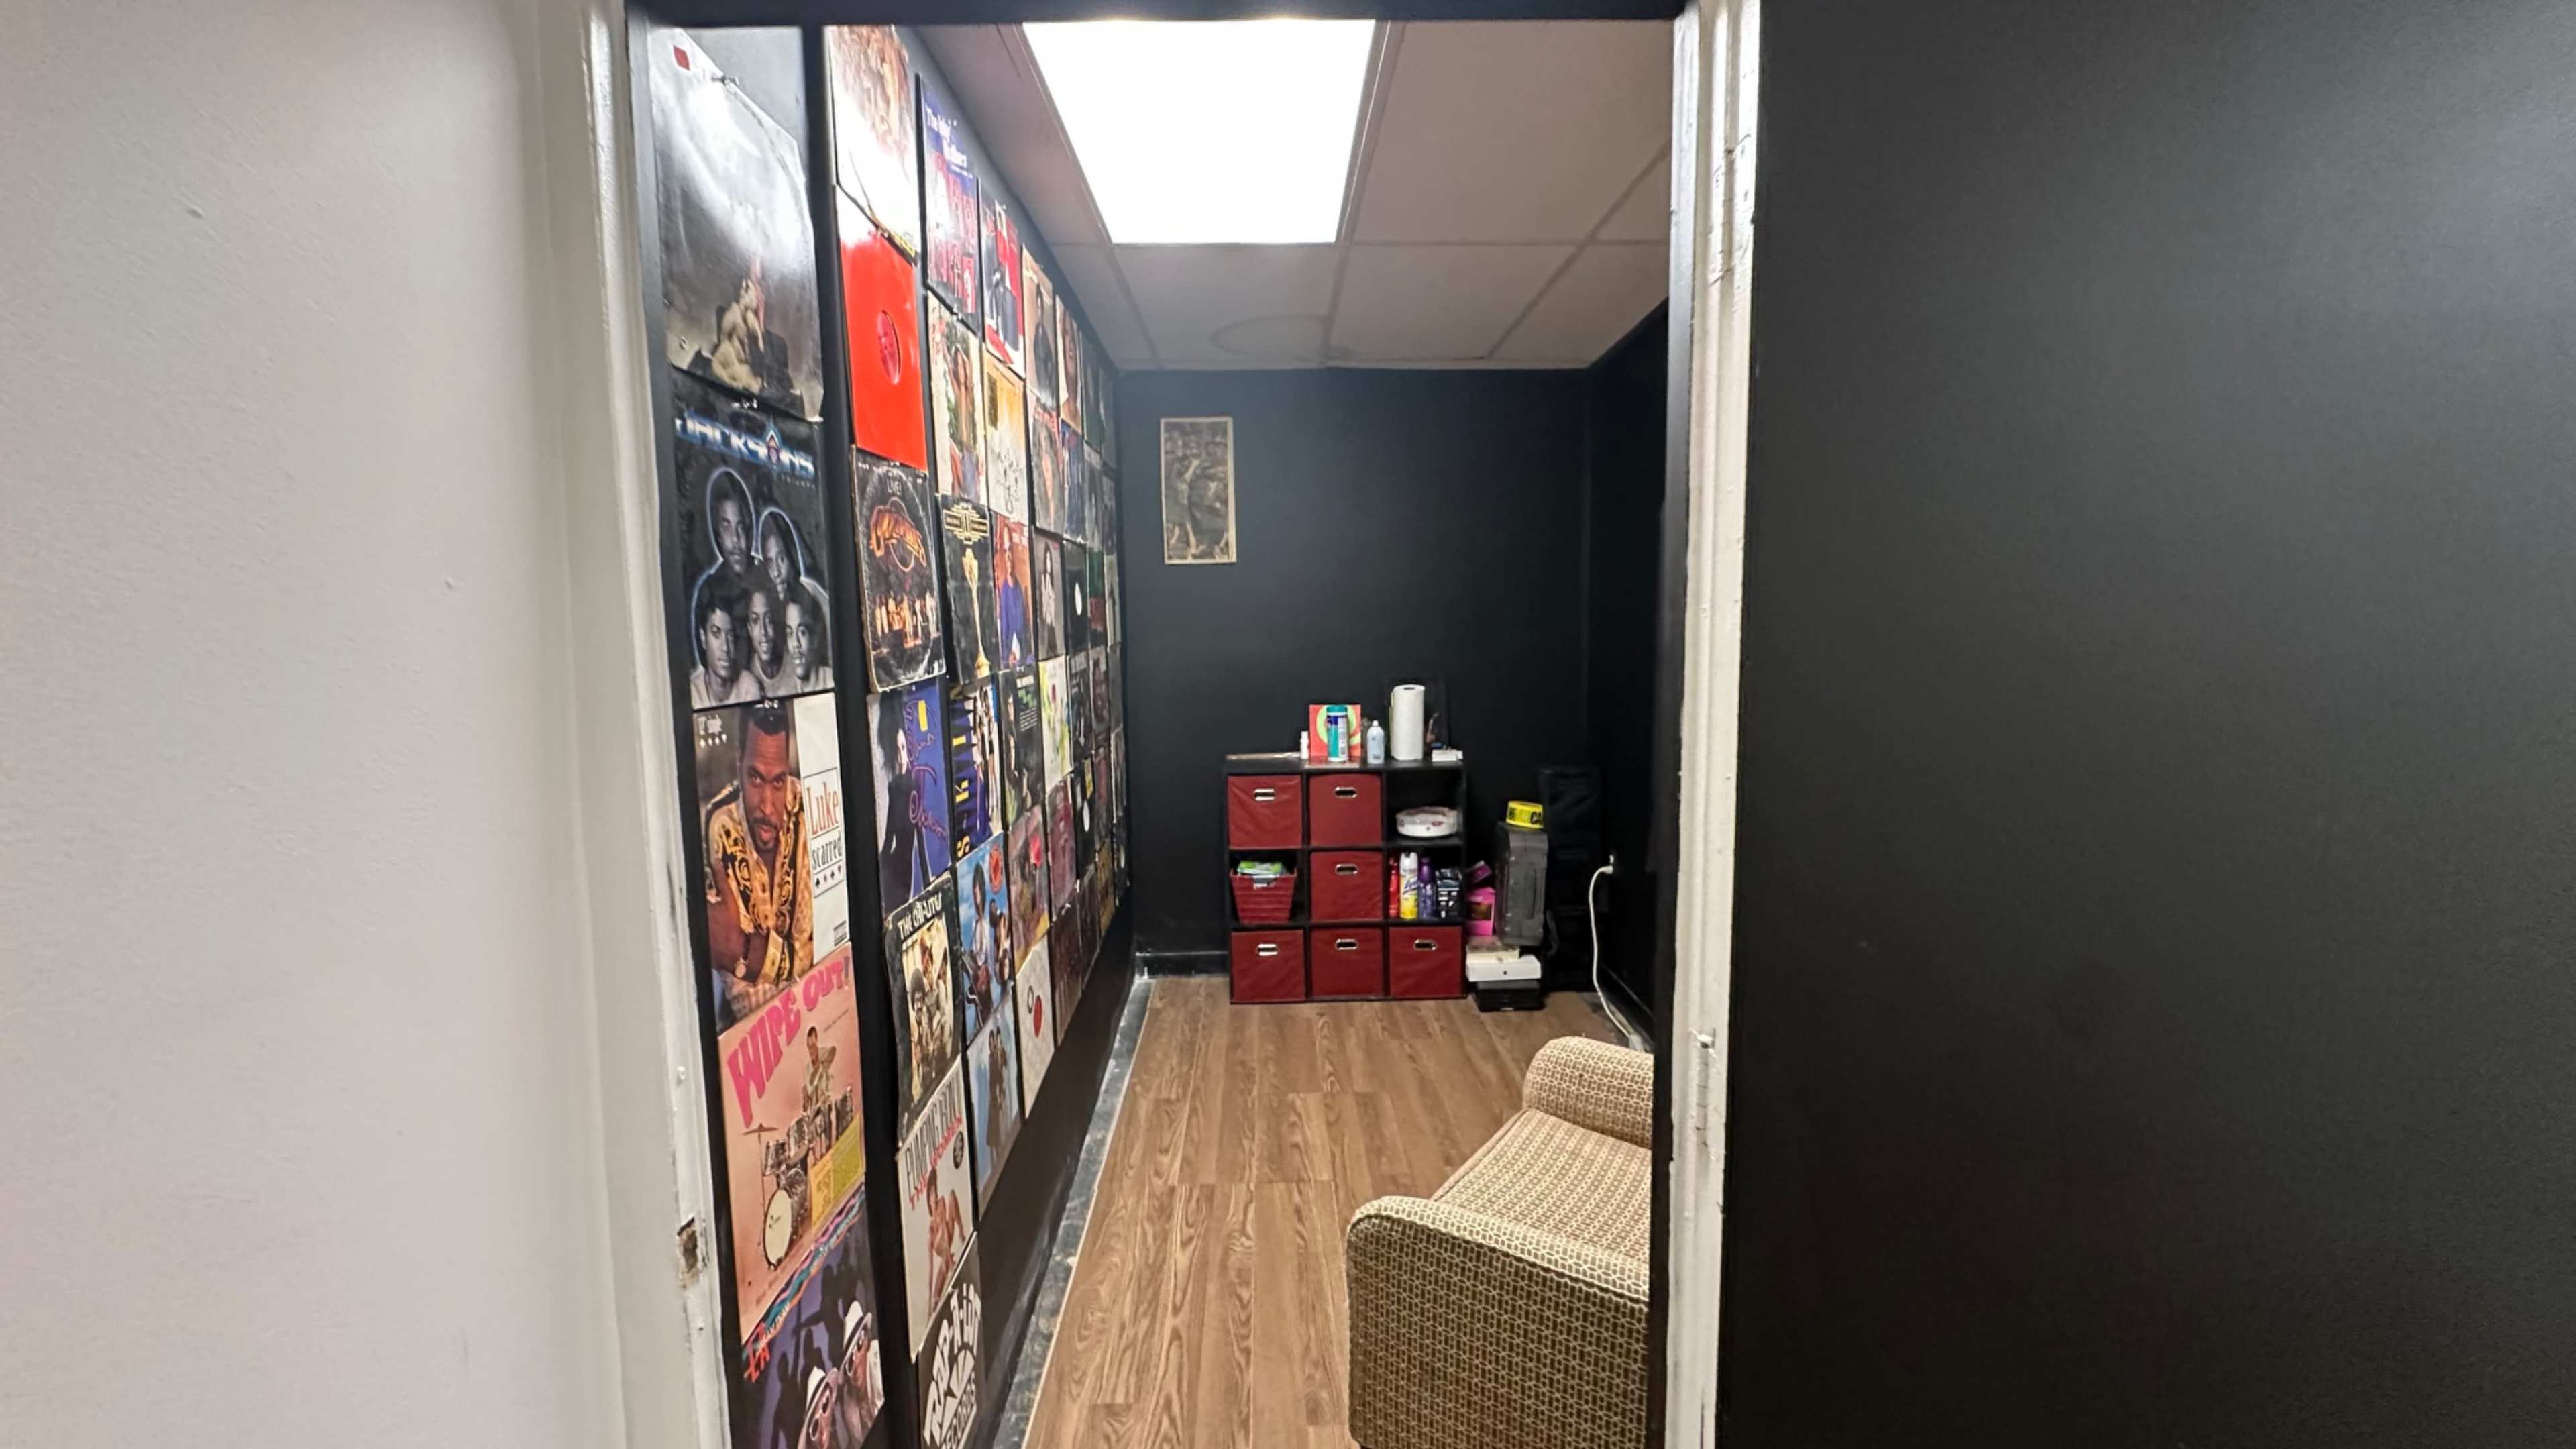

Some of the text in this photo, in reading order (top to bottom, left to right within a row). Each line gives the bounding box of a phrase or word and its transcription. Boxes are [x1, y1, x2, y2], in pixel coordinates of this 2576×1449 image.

[807, 782, 839, 836] Luke
[812, 830, 843, 870] scarred
[898, 914, 913, 940] THE
[727, 989, 801, 1129] WIPE
[803, 956, 851, 1012] OUT!
[910, 1170, 928, 1210] THE
[942, 1371, 976, 1449] ECORDS
